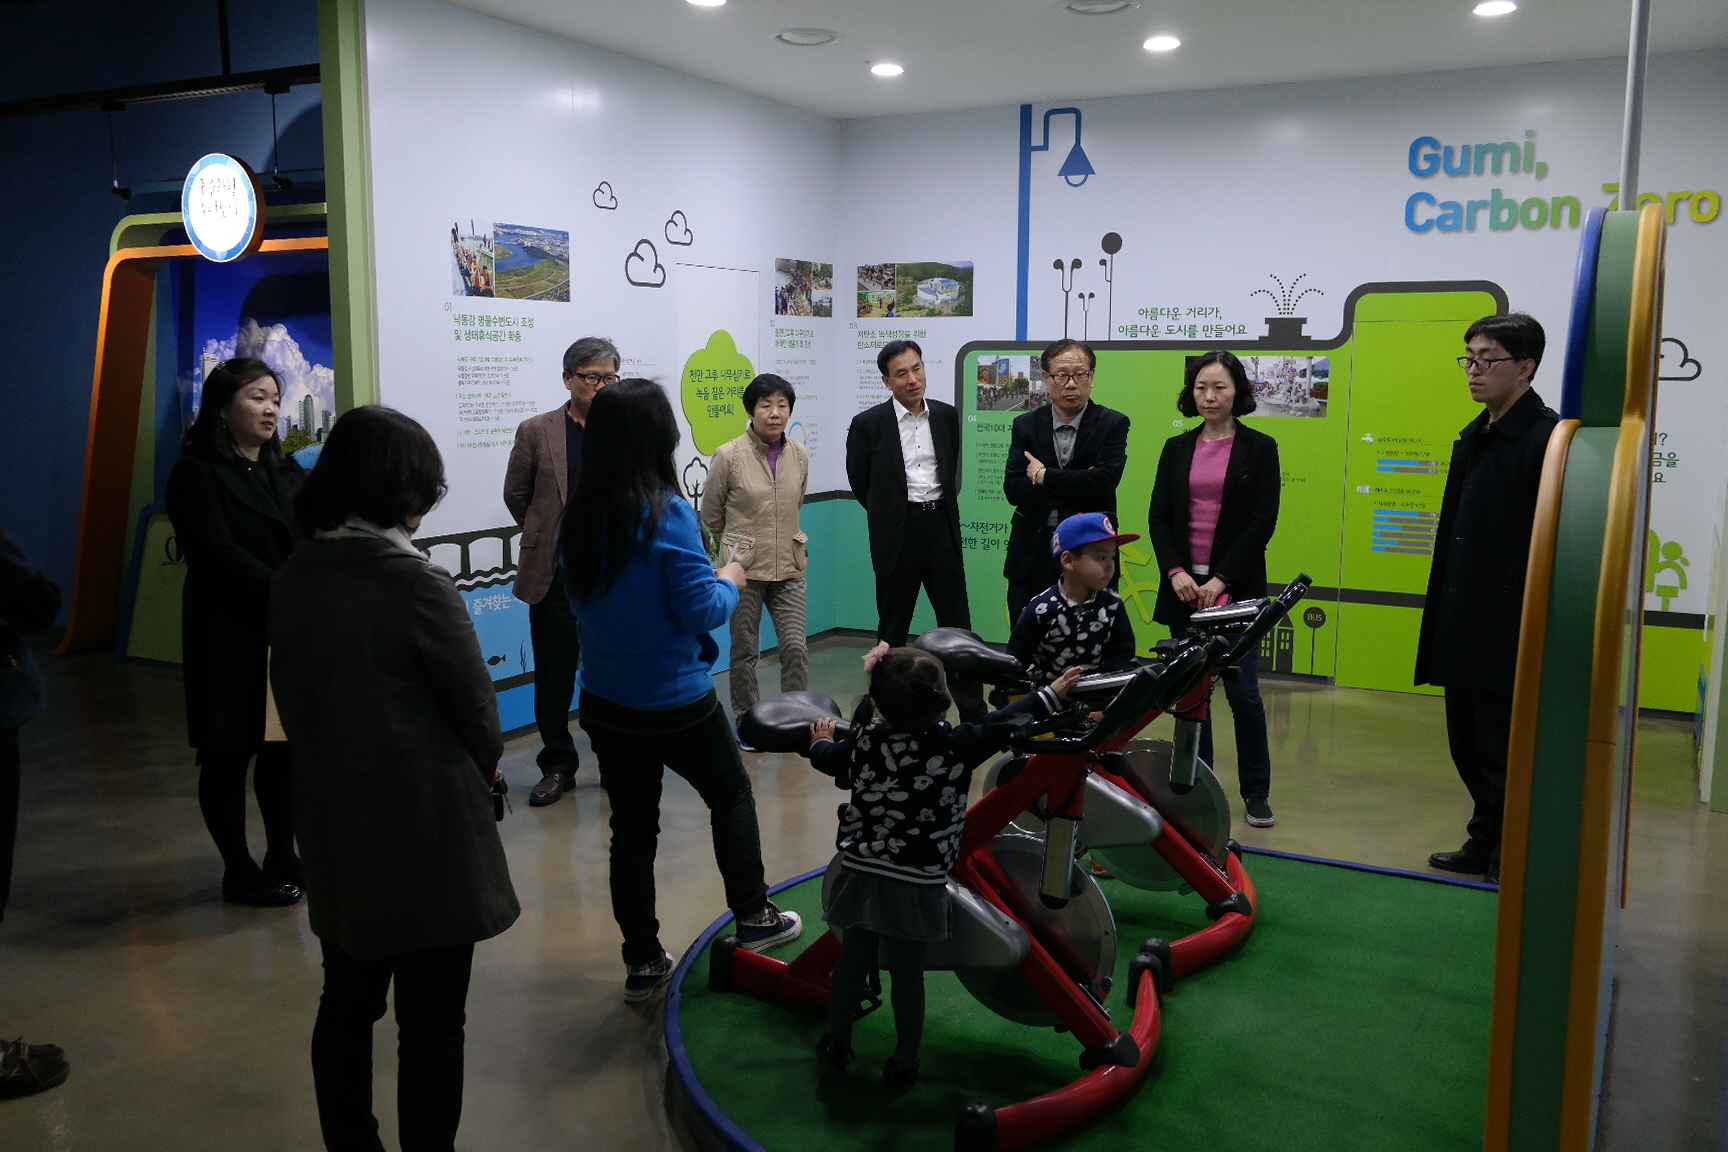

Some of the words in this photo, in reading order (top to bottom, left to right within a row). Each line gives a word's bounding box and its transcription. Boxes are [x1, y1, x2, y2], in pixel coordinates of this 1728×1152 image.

[1408, 129, 1547, 179] Gumi,
[1404, 188, 1579, 232] Carbon
[1138, 306, 1182, 321] 아름다운
[1186, 306, 1222, 321] 거리가,
[454, 313, 476, 326] 낙동강
[478, 314, 519, 328] 명품수변도시
[521, 317, 534, 329] 조성
[454, 329, 462, 341] 및
[464, 329, 506, 342] 생태휴식공간
[508, 330, 522, 343] 확충
[857, 330, 876, 339] 저탄소
[879, 329, 911, 339] 녹색성장을
[913, 330, 927, 339] 위한
[1118, 324, 1161, 338] 아름다운
[1164, 324, 1198, 338] 도시를
[1202, 324, 1247, 338] 만들어요
[689, 369, 703, 383] 천만
[705, 369, 719, 382] 그루
[721, 369, 751, 382] 나무심기로
[696, 386, 710, 400] 녹음
[726, 386, 745, 400] 거리를
[707, 404, 734, 418] 만들어요!
[1172, 419, 1183, 428] 05
[981, 538, 1000, 551] 길이
[472, 593, 511, 615] 즐겨찾는
[1307, 613, 1322, 622] BUS
